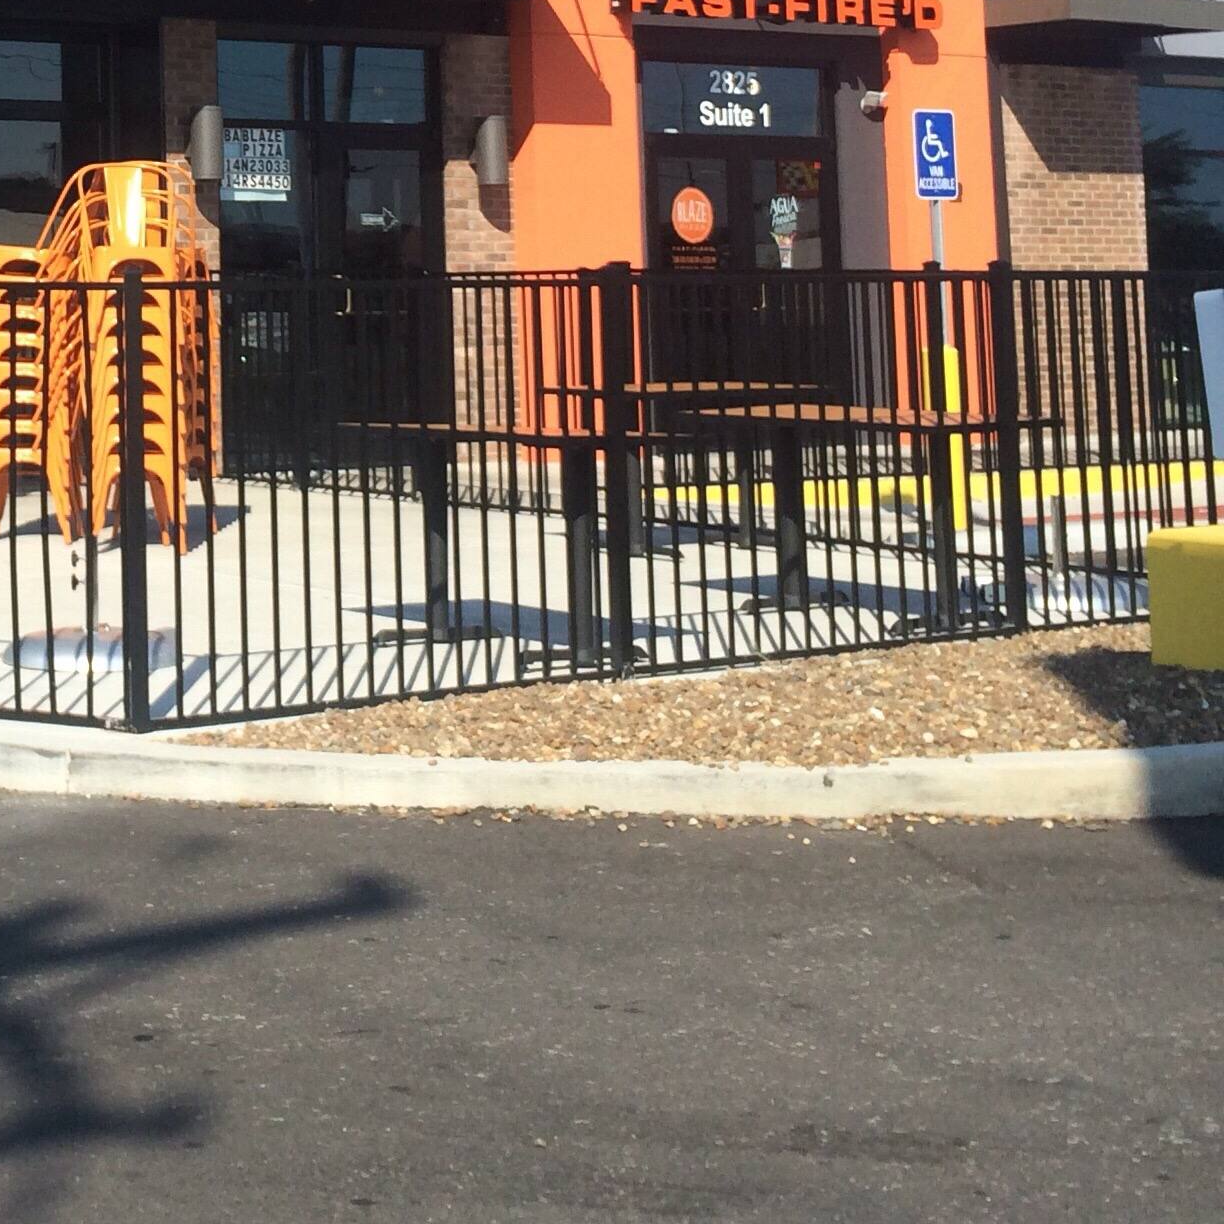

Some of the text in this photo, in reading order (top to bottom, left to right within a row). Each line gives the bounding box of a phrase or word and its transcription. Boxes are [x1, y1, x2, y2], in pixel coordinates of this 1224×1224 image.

[709, 69, 761, 96] 2825
[699, 100, 772, 128] Suite 1
[243, 143, 283, 157] PIZZA
